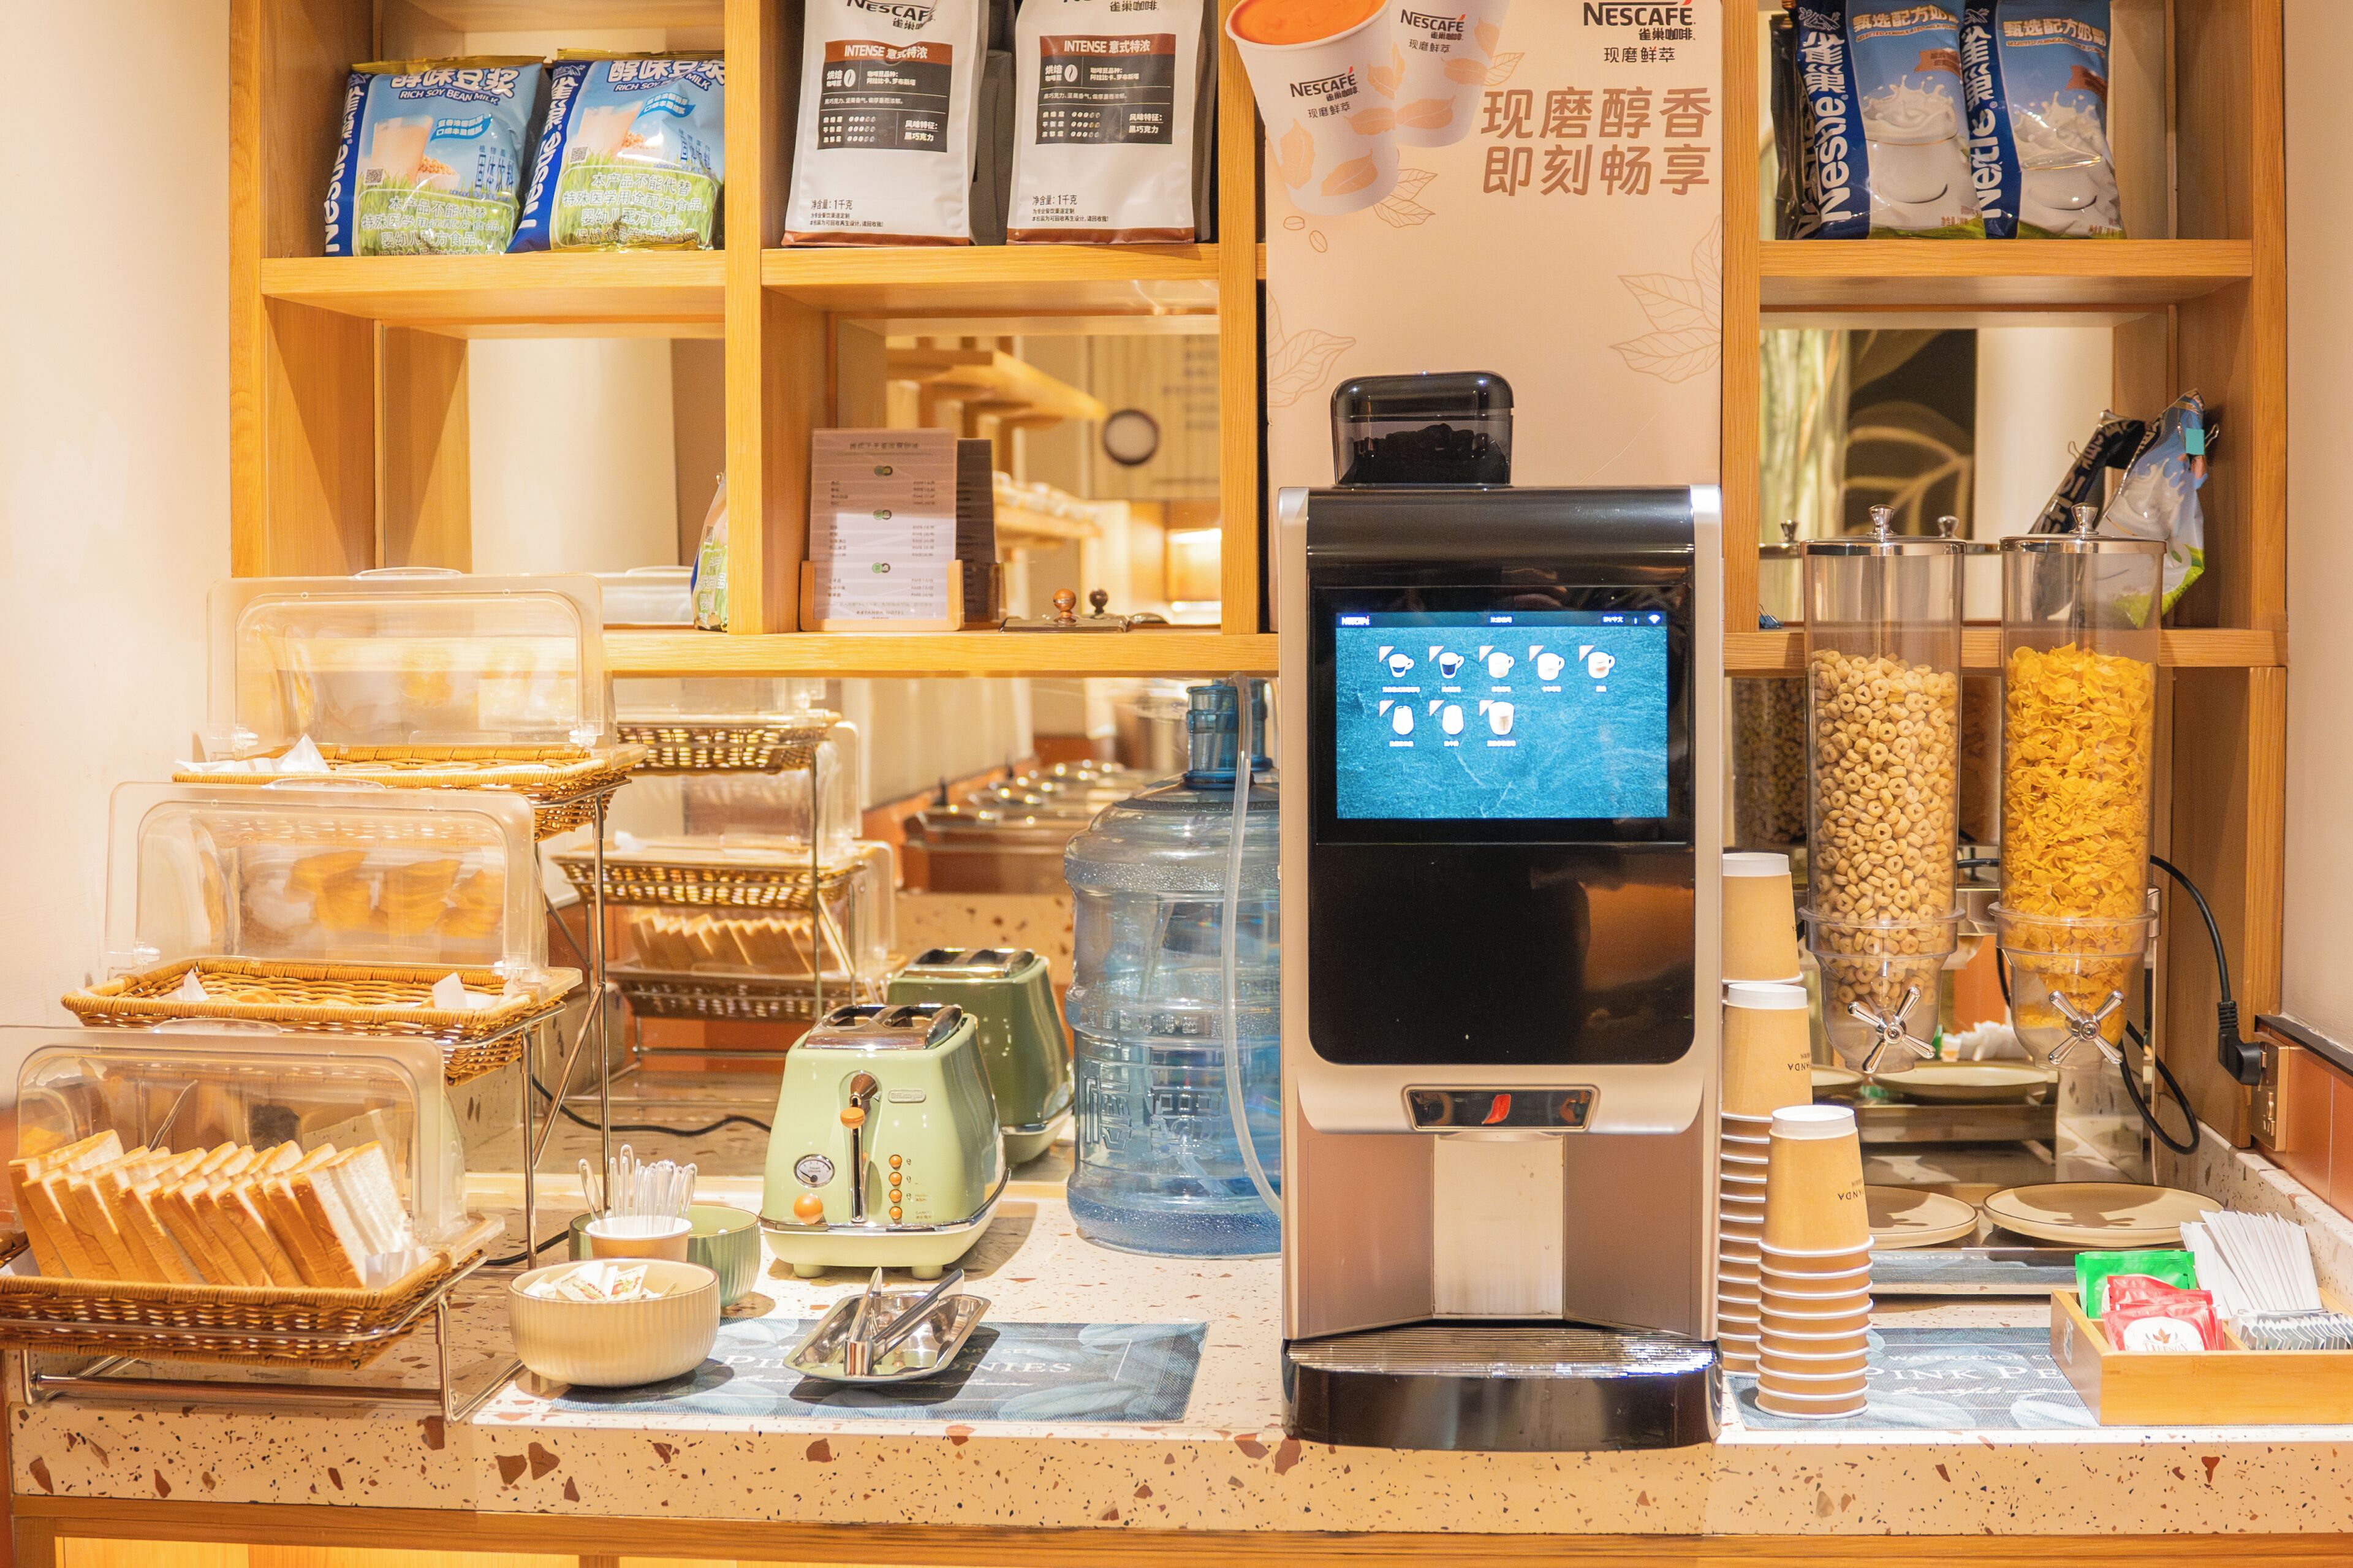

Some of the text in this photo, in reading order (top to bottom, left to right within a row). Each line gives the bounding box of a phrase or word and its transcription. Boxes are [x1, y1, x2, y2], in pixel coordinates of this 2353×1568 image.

[1639, 28, 1693, 40] 雀巢咖啡
[844, 45, 928, 59] INTENSE 意式特浓
[1064, 40, 1150, 53] INTENSE 意式特浓
[1409, 39, 1450, 53] 现磨鲜萃
[1604, 47, 1675, 62] 现磨鲜萃
[1802, 31, 1845, 93] 雀巢
[1045, 65, 1063, 74] 烘焙
[614, 83, 639, 91] RICH
[685, 72, 712, 91] MILK
[400, 89, 500, 105] RICH SOY BEAN MILK
[1308, 102, 1350, 118] 现磨鲜萃
[1480, 86, 1712, 138] 现磨醇香
[1483, 144, 1711, 196] 即刻畅享
[592, 172, 691, 196] 本产品不能代替
[389, 196, 487, 218] 本产品不能代替
